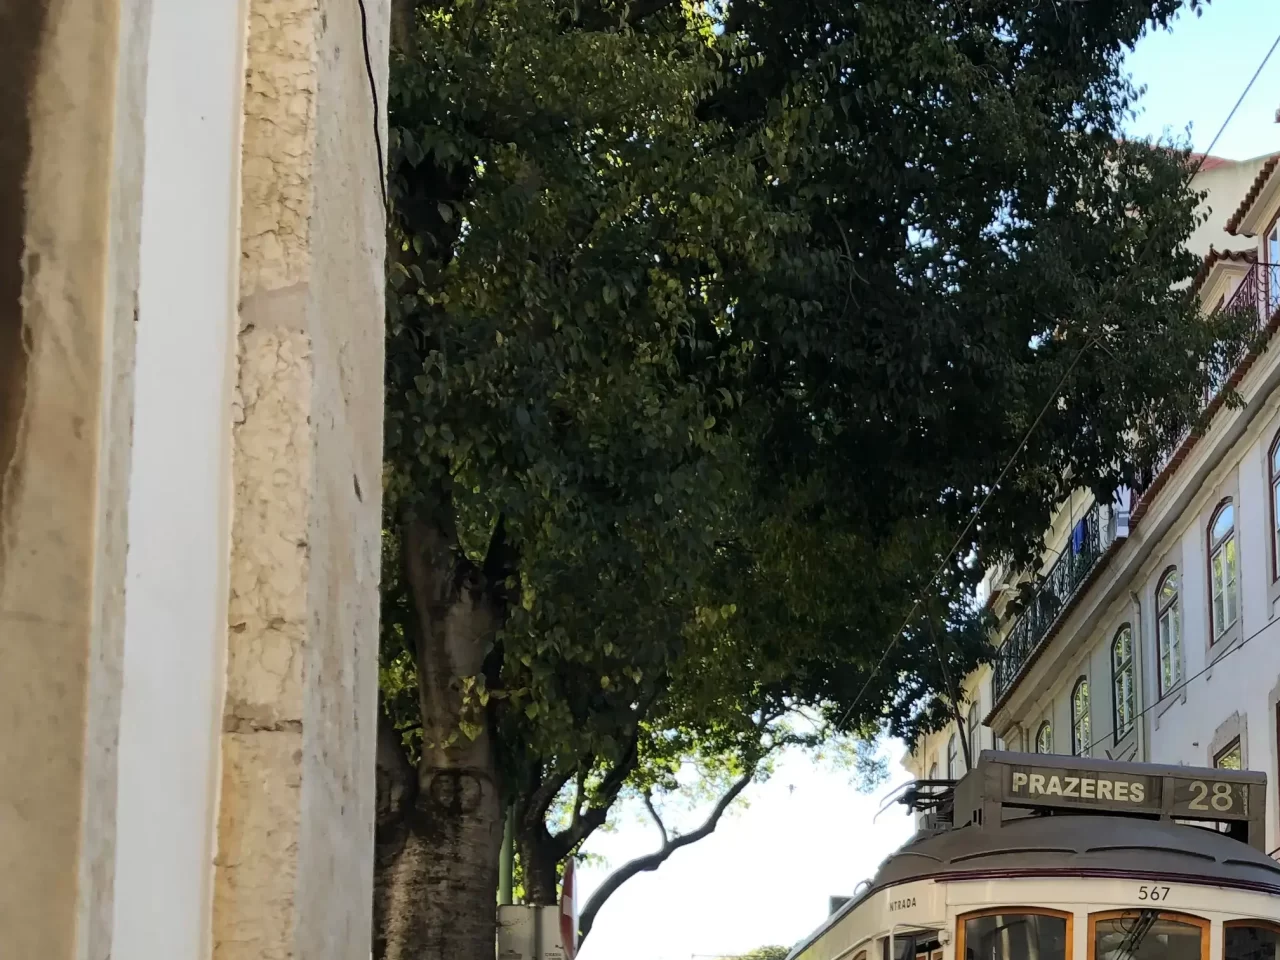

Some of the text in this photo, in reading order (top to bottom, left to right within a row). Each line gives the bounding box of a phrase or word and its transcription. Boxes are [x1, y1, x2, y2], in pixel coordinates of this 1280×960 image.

[1012, 772, 1145, 803] PRAZERES
[1188, 781, 1233, 811] 28
[886, 897, 917, 913] NTRADA
[1138, 886, 1171, 901] 567
